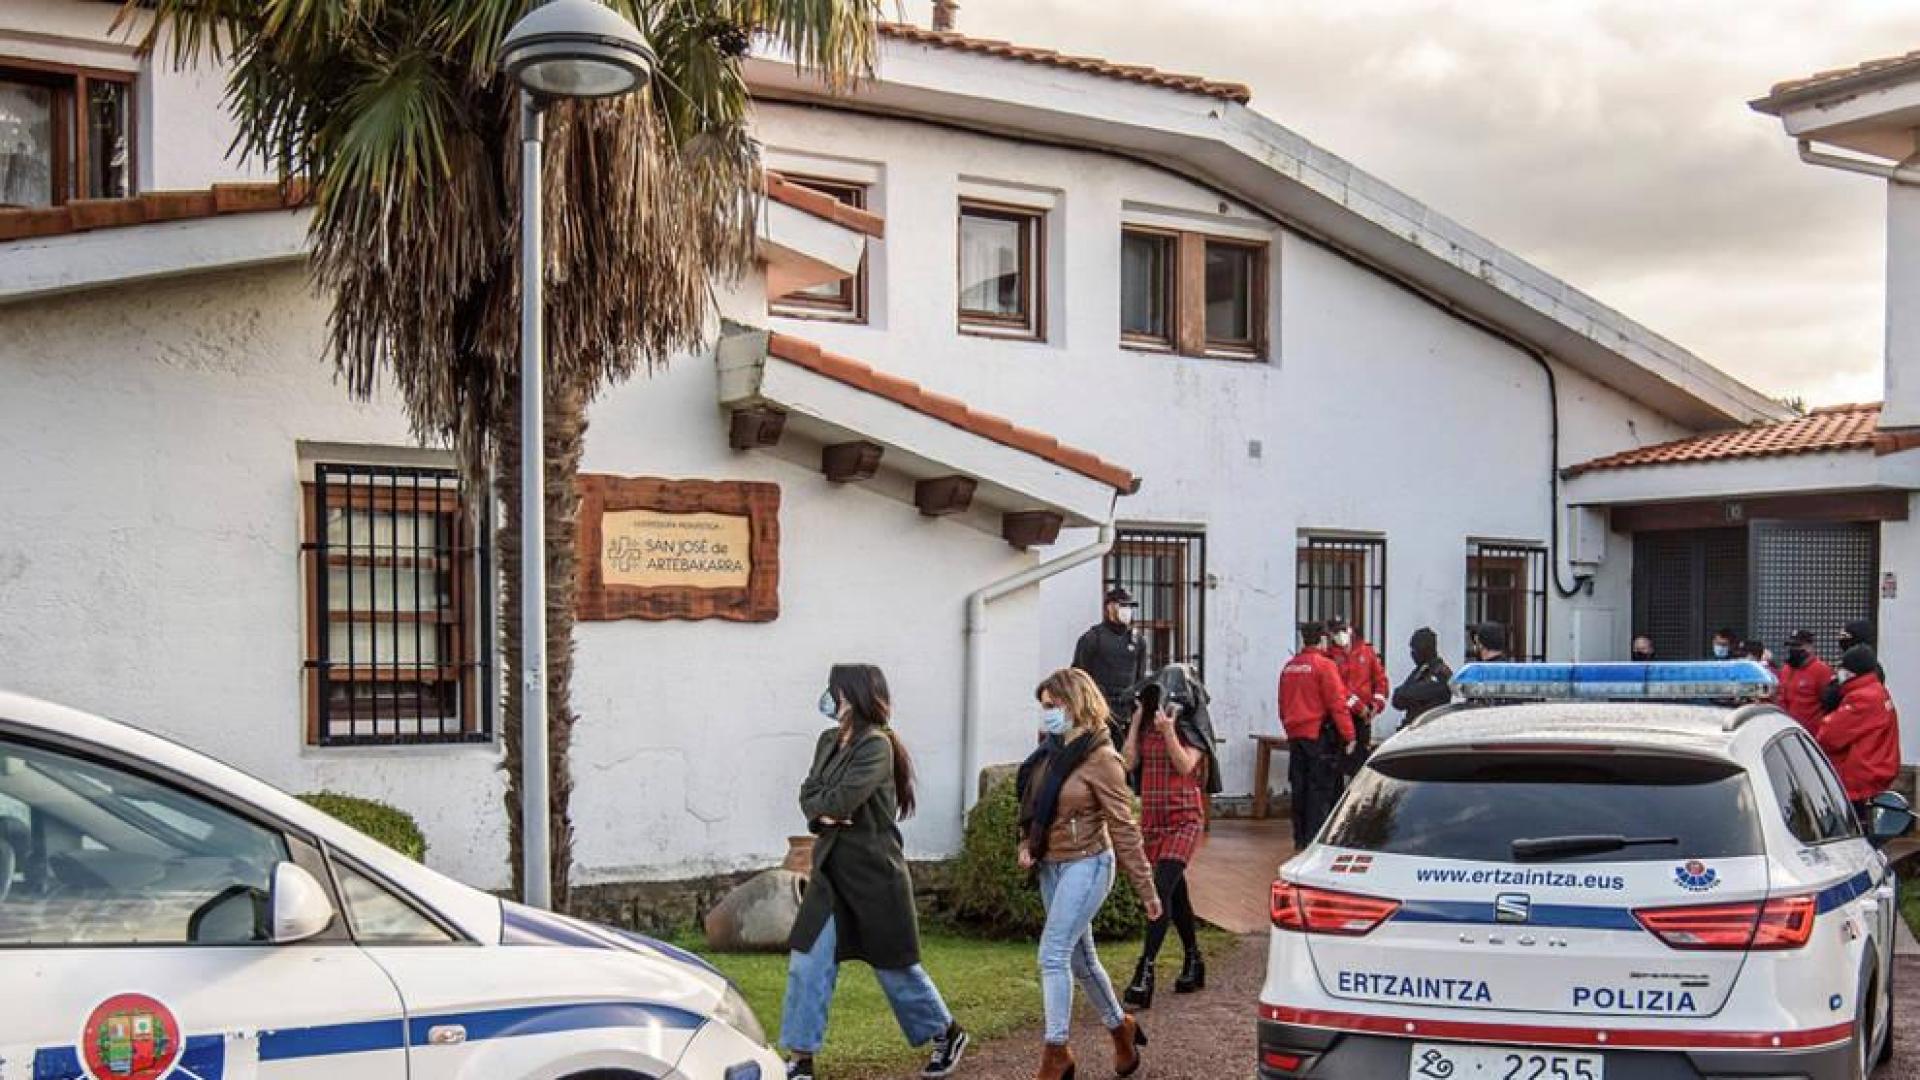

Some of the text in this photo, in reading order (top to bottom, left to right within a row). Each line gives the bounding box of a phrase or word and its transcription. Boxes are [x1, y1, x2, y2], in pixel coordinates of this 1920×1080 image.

[645, 537, 729, 556] SAN JOSÉ de
[646, 558, 744, 572] ARTEBAKARRA
[1416, 867, 1625, 891] www.ertzaintza.eus
[1338, 971, 1493, 1002] ERTZAINTZA
[1572, 986, 1697, 1012] POLIZIA
[1504, 1054, 1593, 1080] 2255
